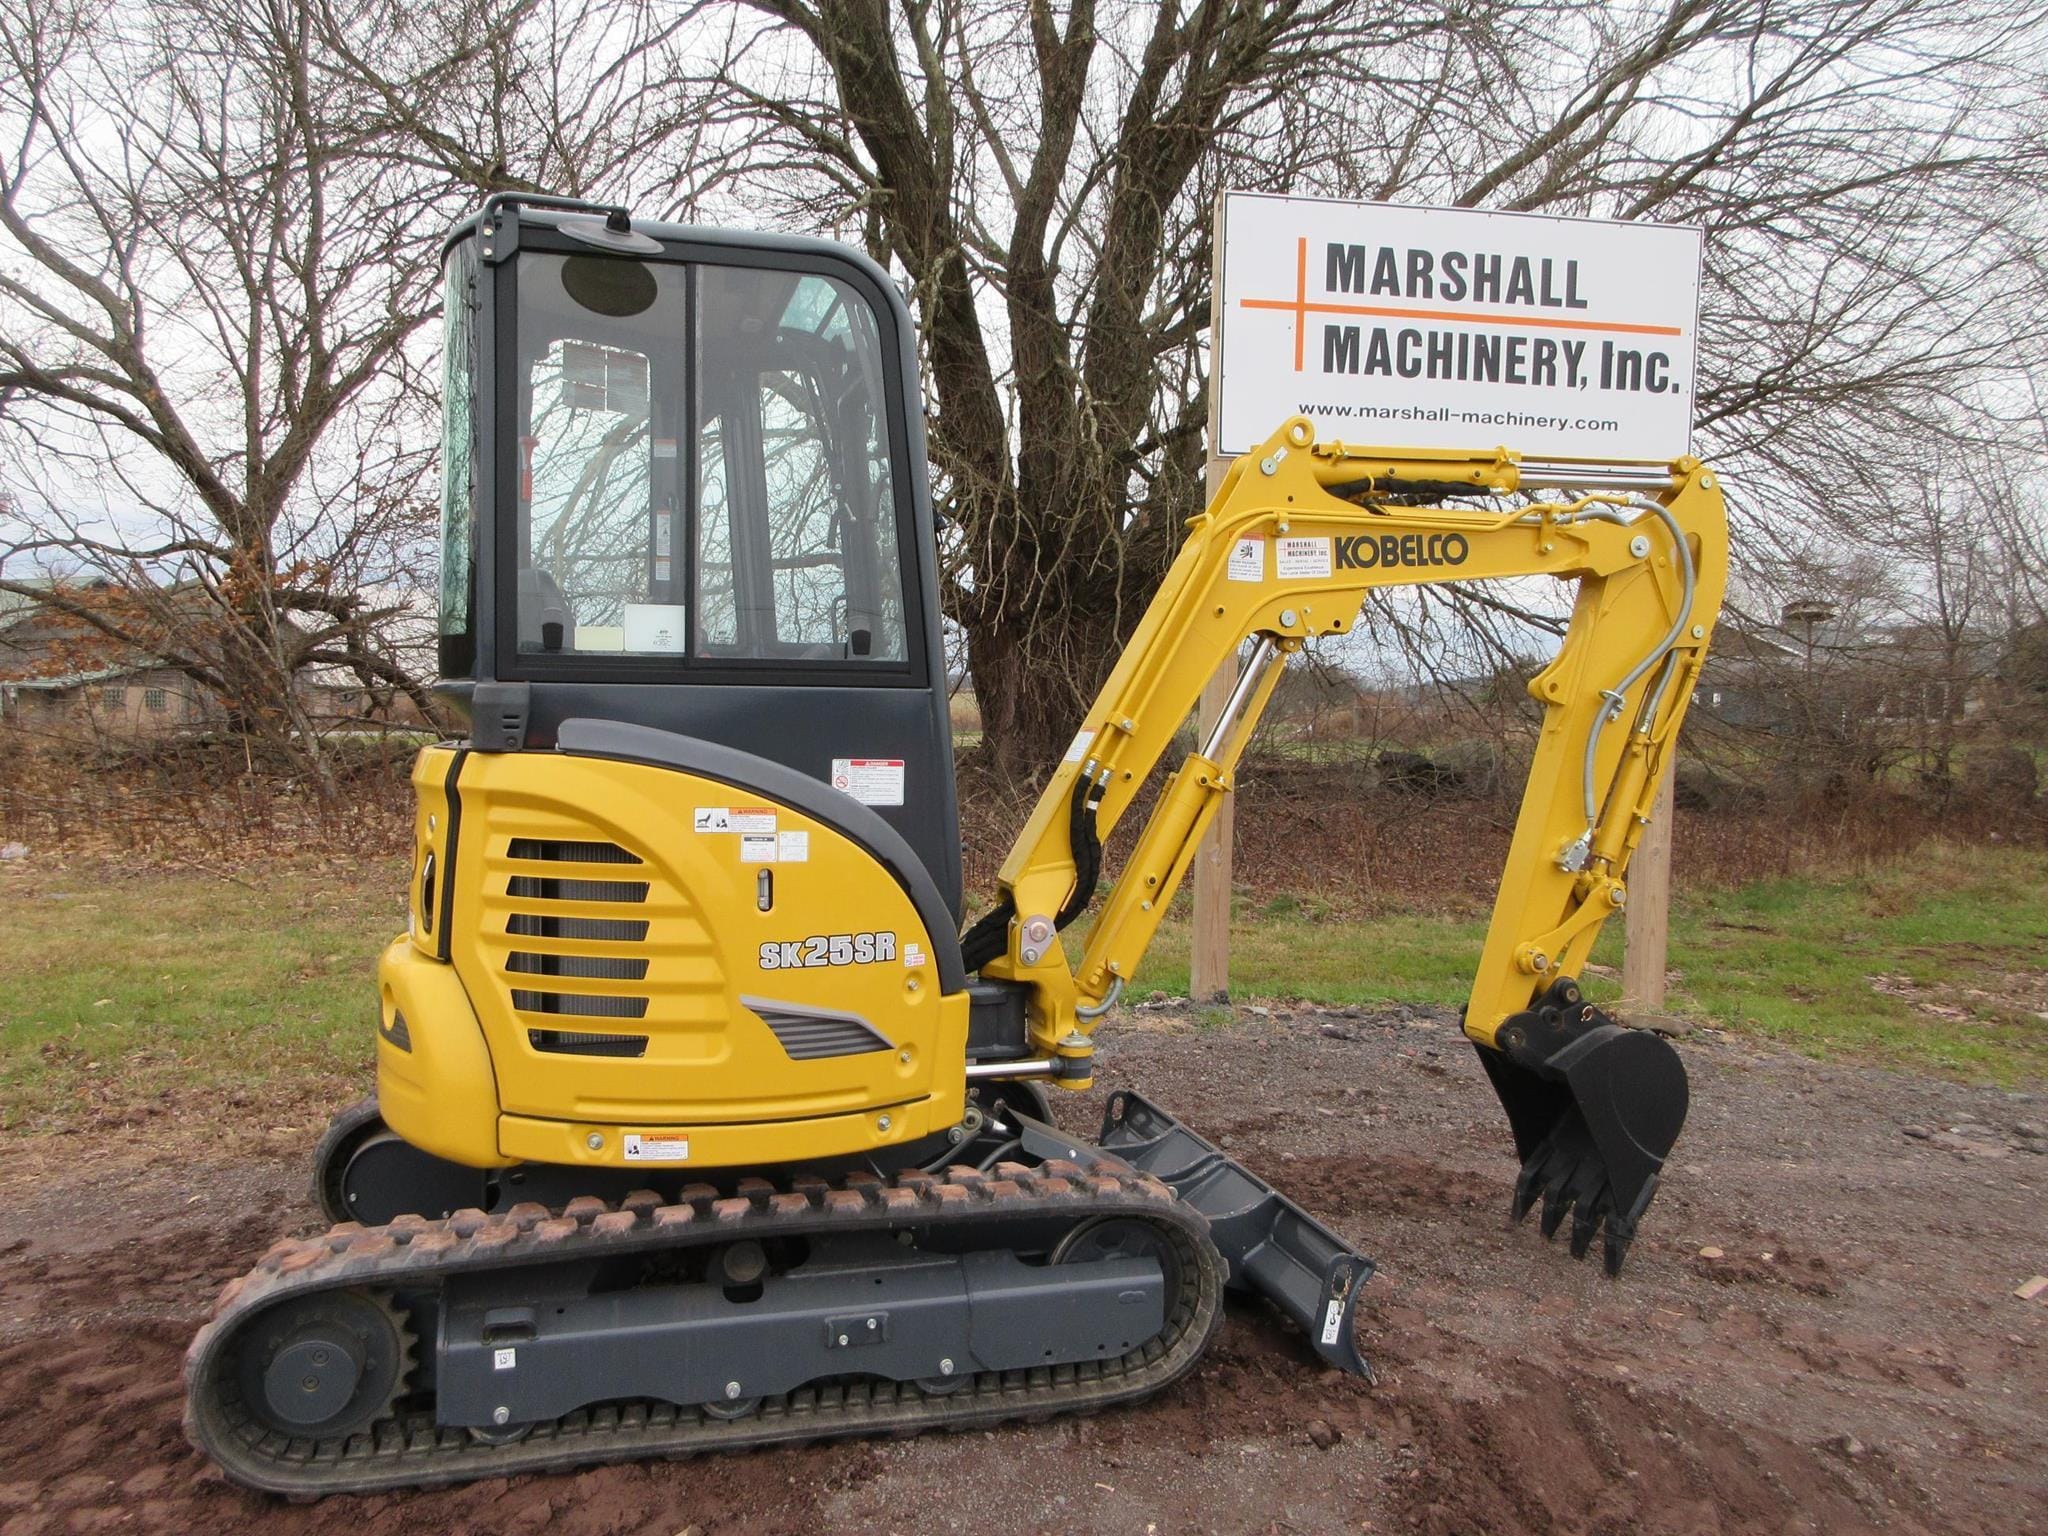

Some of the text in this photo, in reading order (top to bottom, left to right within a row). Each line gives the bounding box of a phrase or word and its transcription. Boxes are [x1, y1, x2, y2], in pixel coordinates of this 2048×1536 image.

[1326, 243, 1588, 309] MARSHALL
[1323, 325, 1680, 394] MACHINERY, Inc.
[1299, 404, 1618, 431] www.marshall-machinery.com
[1334, 532, 1469, 569] KOBELCO
[759, 931, 896, 970] SK25SR
